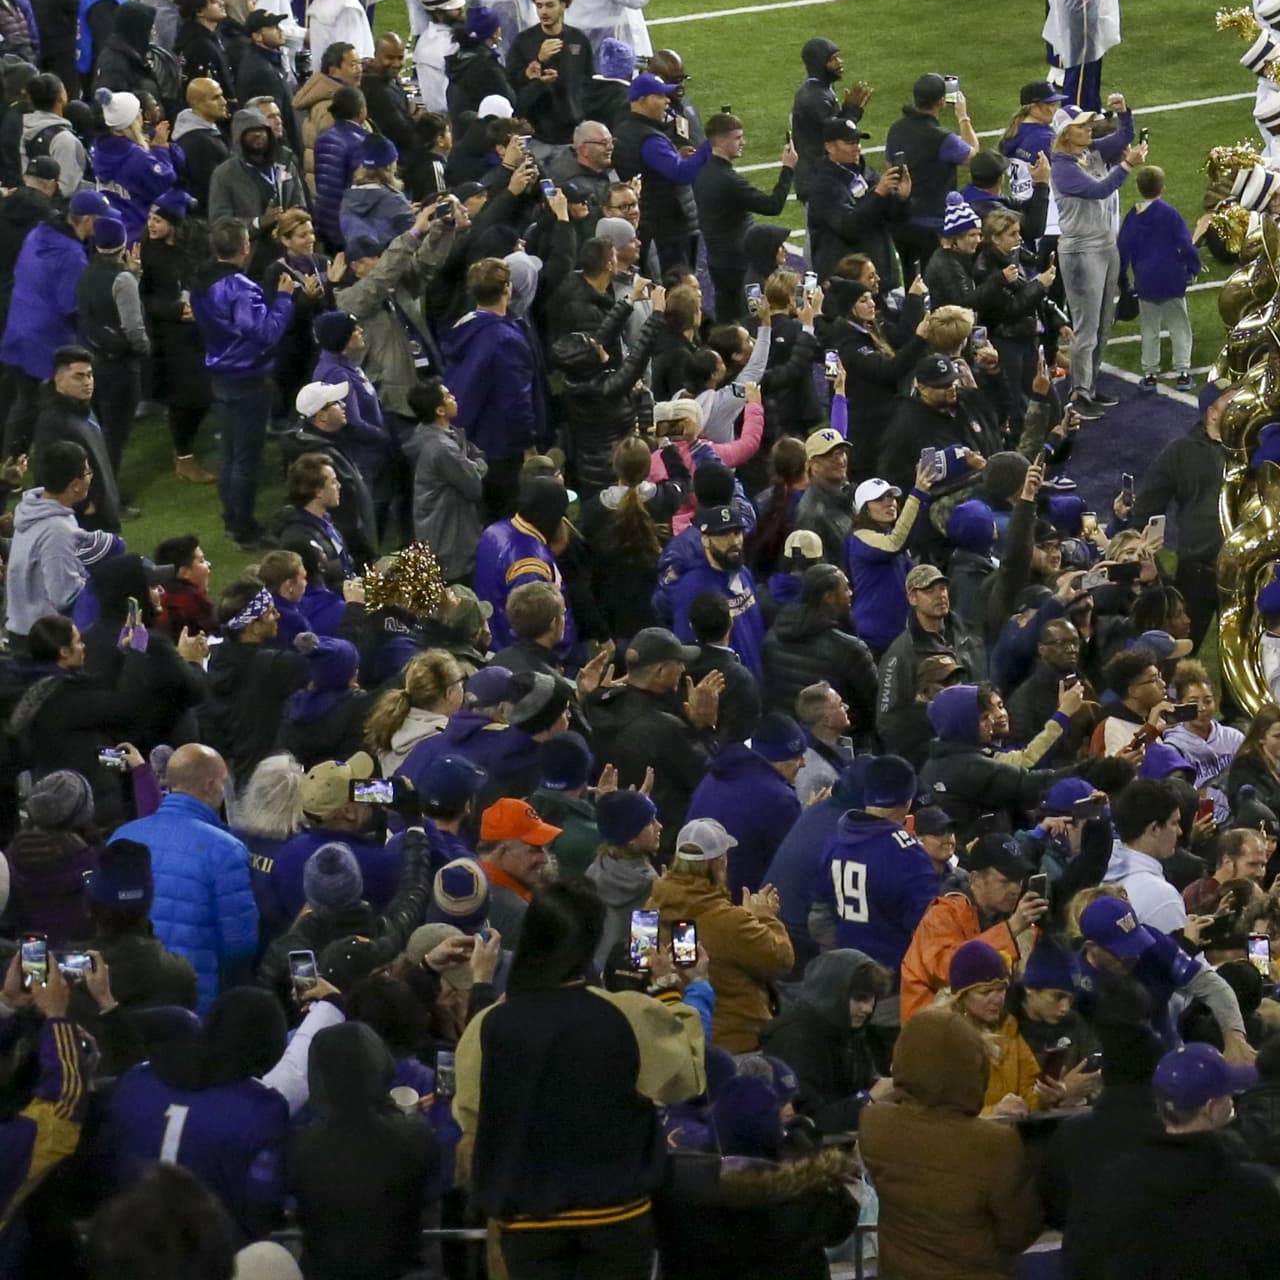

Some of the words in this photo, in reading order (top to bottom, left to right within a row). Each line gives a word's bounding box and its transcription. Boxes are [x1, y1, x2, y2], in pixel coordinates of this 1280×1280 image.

[937, 361, 948, 373] S
[822, 431, 837, 442] W
[720, 507, 732, 521] S
[831, 858, 870, 922] 19
[159, 1104, 188, 1165] 1
